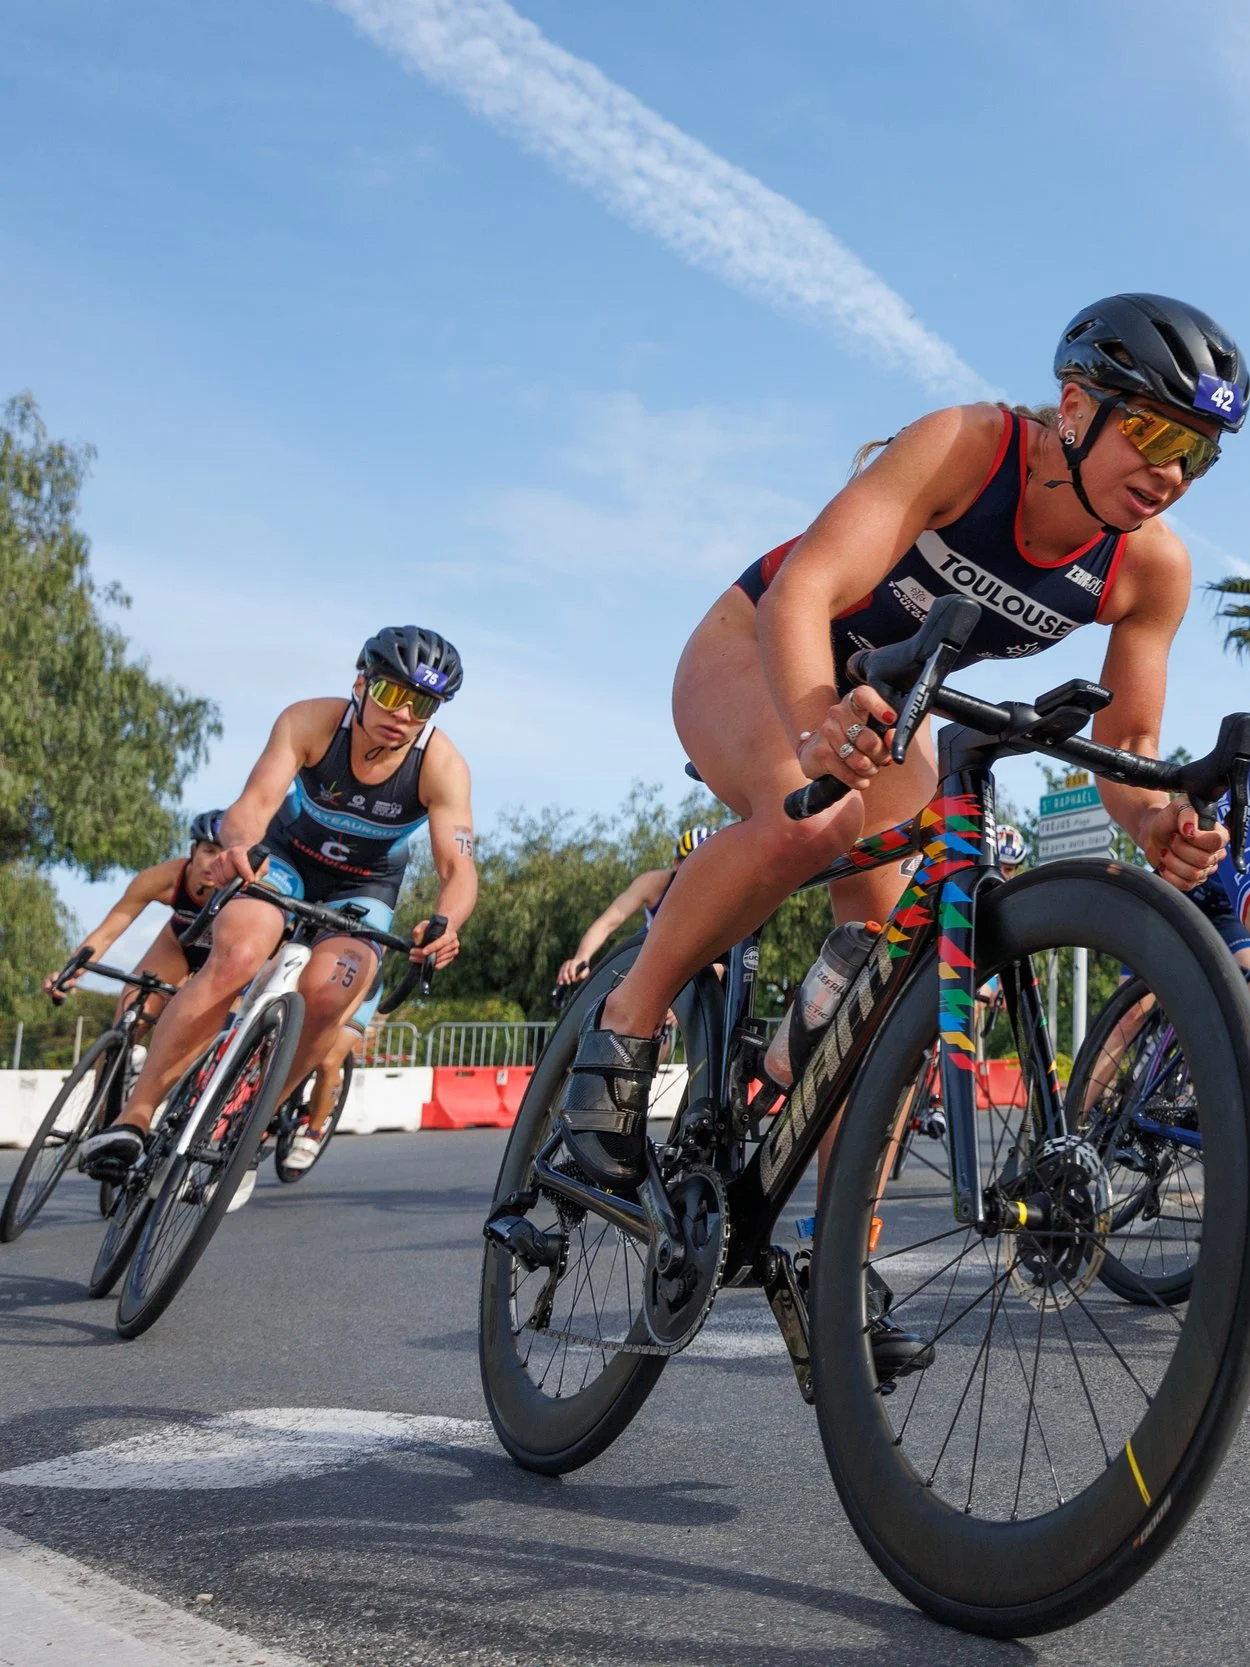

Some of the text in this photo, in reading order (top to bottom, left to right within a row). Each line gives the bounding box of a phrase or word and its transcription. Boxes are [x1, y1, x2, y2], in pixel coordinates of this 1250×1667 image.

[1210, 387, 1234, 412] 42
[939, 554, 1073, 637] TOULOUSE
[1086, 684, 1110, 697] GARMIN
[455, 837, 473, 857] 75
[609, 1034, 631, 1063] SHIMANO
[760, 932, 893, 1197] GIANT
